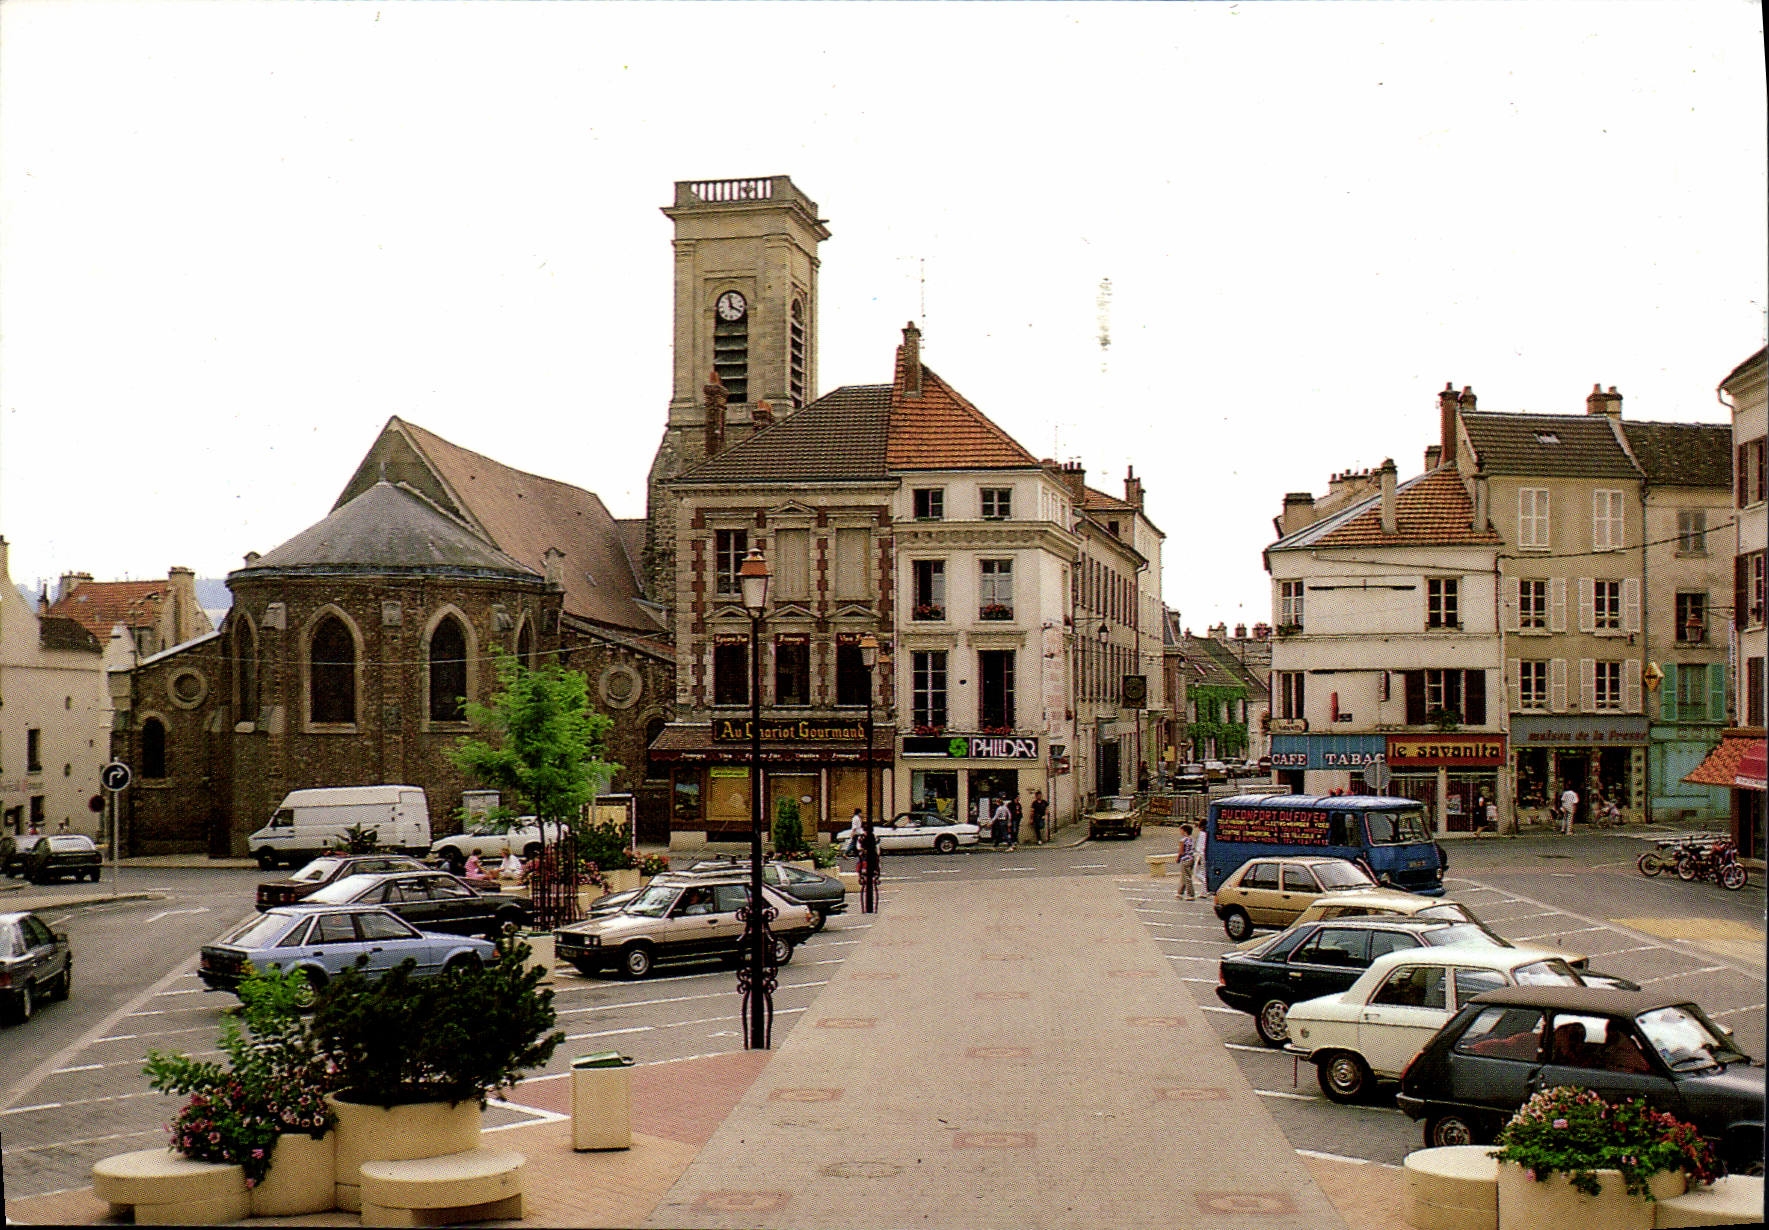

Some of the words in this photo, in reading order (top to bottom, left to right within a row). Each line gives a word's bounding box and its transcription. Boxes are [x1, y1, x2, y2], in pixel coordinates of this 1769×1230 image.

[720, 721, 743, 738] Au
[745, 721, 795, 738] Cariot
[798, 721, 865, 738] Gourmand
[971, 738, 1037, 757] PHILDAR
[1392, 743, 1407, 757] le
[1417, 743, 1500, 757] savanita
[1271, 753, 1307, 765] CAFE
[1325, 753, 1385, 765] TABAC
[1221, 809, 1233, 819] AU
[1234, 809, 1278, 821] CONFORT
[1279, 811, 1293, 822] DU
[1294, 811, 1327, 823] FOYER
